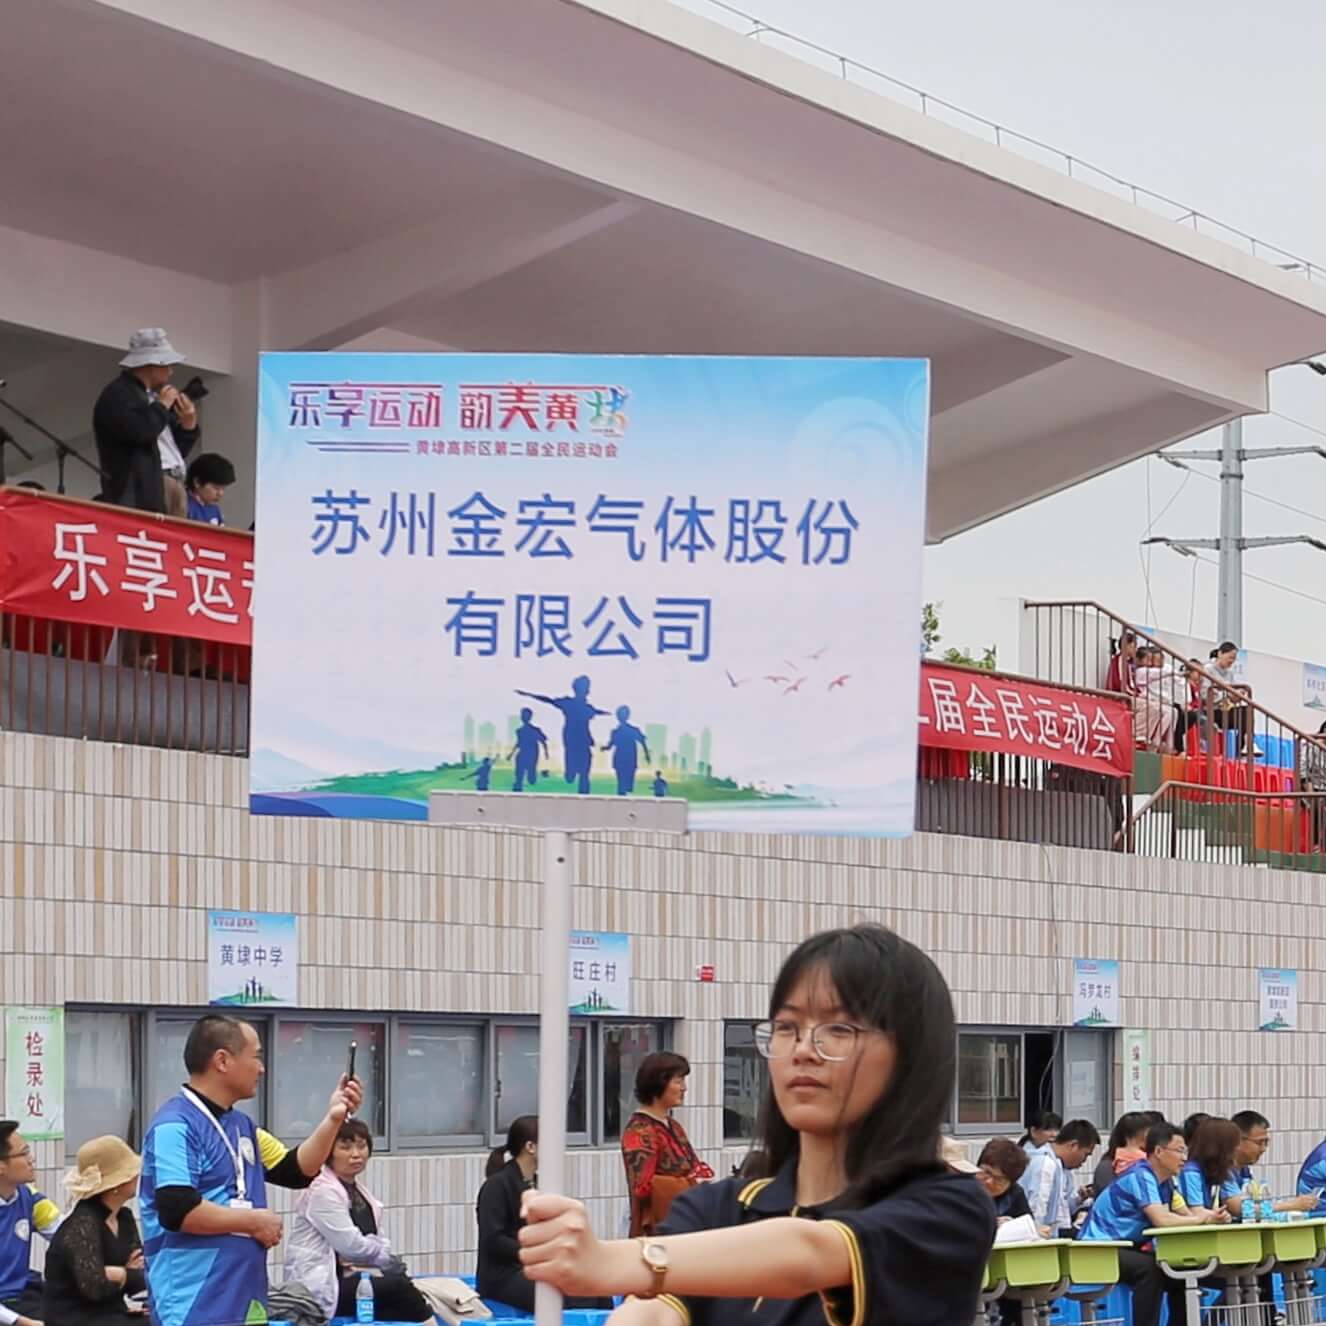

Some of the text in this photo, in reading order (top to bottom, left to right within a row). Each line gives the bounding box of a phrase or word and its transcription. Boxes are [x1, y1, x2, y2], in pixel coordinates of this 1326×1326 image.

[288, 382, 444, 429] 乐享运动
[310, 489, 861, 567] 苏州金宏气体股份
[52, 522, 254, 624] 乐享运
[443, 590, 712, 663] 有限公司
[918, 677, 1116, 761] 届全民运动会
[220, 944, 283, 968] 黄埭中学
[573, 960, 616, 982] 旺庄村
[25, 1030, 44, 1117] 检录处
